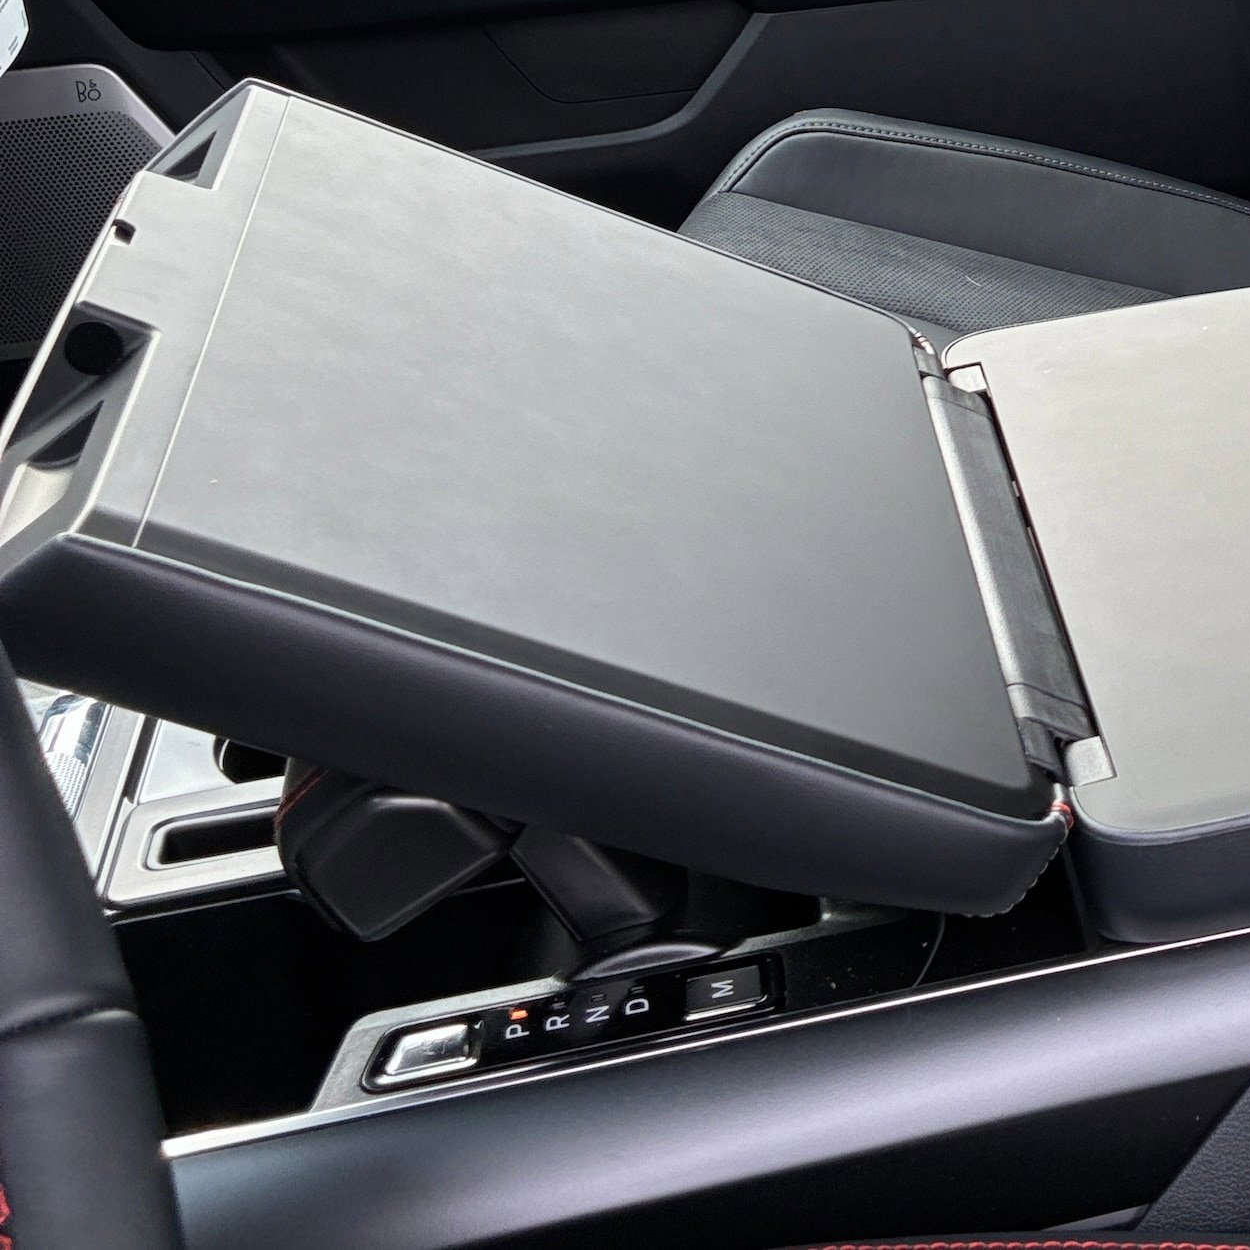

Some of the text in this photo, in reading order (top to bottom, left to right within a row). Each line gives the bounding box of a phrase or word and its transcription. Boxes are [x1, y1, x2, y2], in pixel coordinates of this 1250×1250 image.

[711, 979, 735, 999] M
[506, 998, 650, 1040] P R N D
